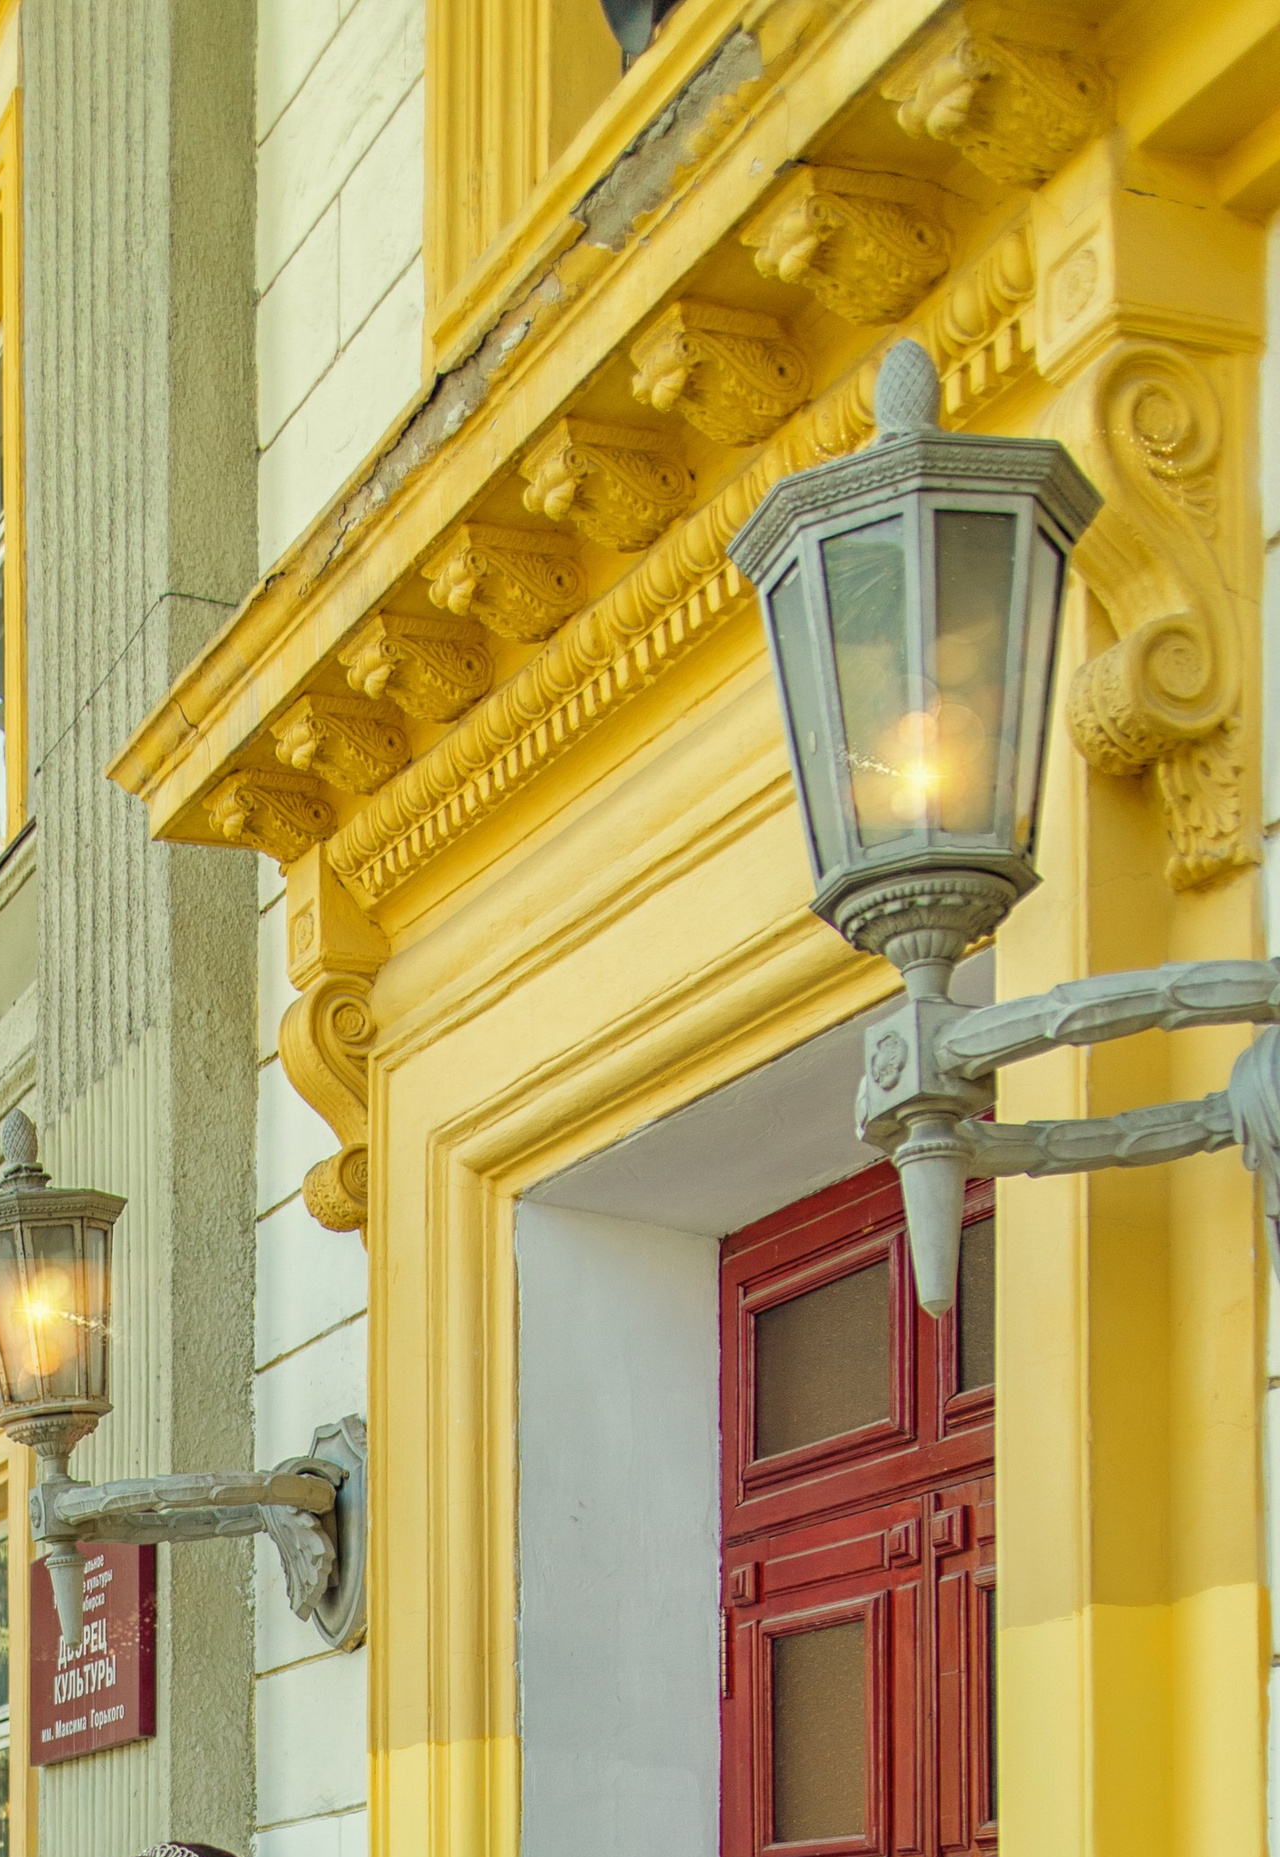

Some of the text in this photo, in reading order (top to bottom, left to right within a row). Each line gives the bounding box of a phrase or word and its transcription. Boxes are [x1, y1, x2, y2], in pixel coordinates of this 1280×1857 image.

[55, 1655, 116, 1705] КУЛЬТУРЫ
[41, 1704, 124, 1743] им. Максима Горького
